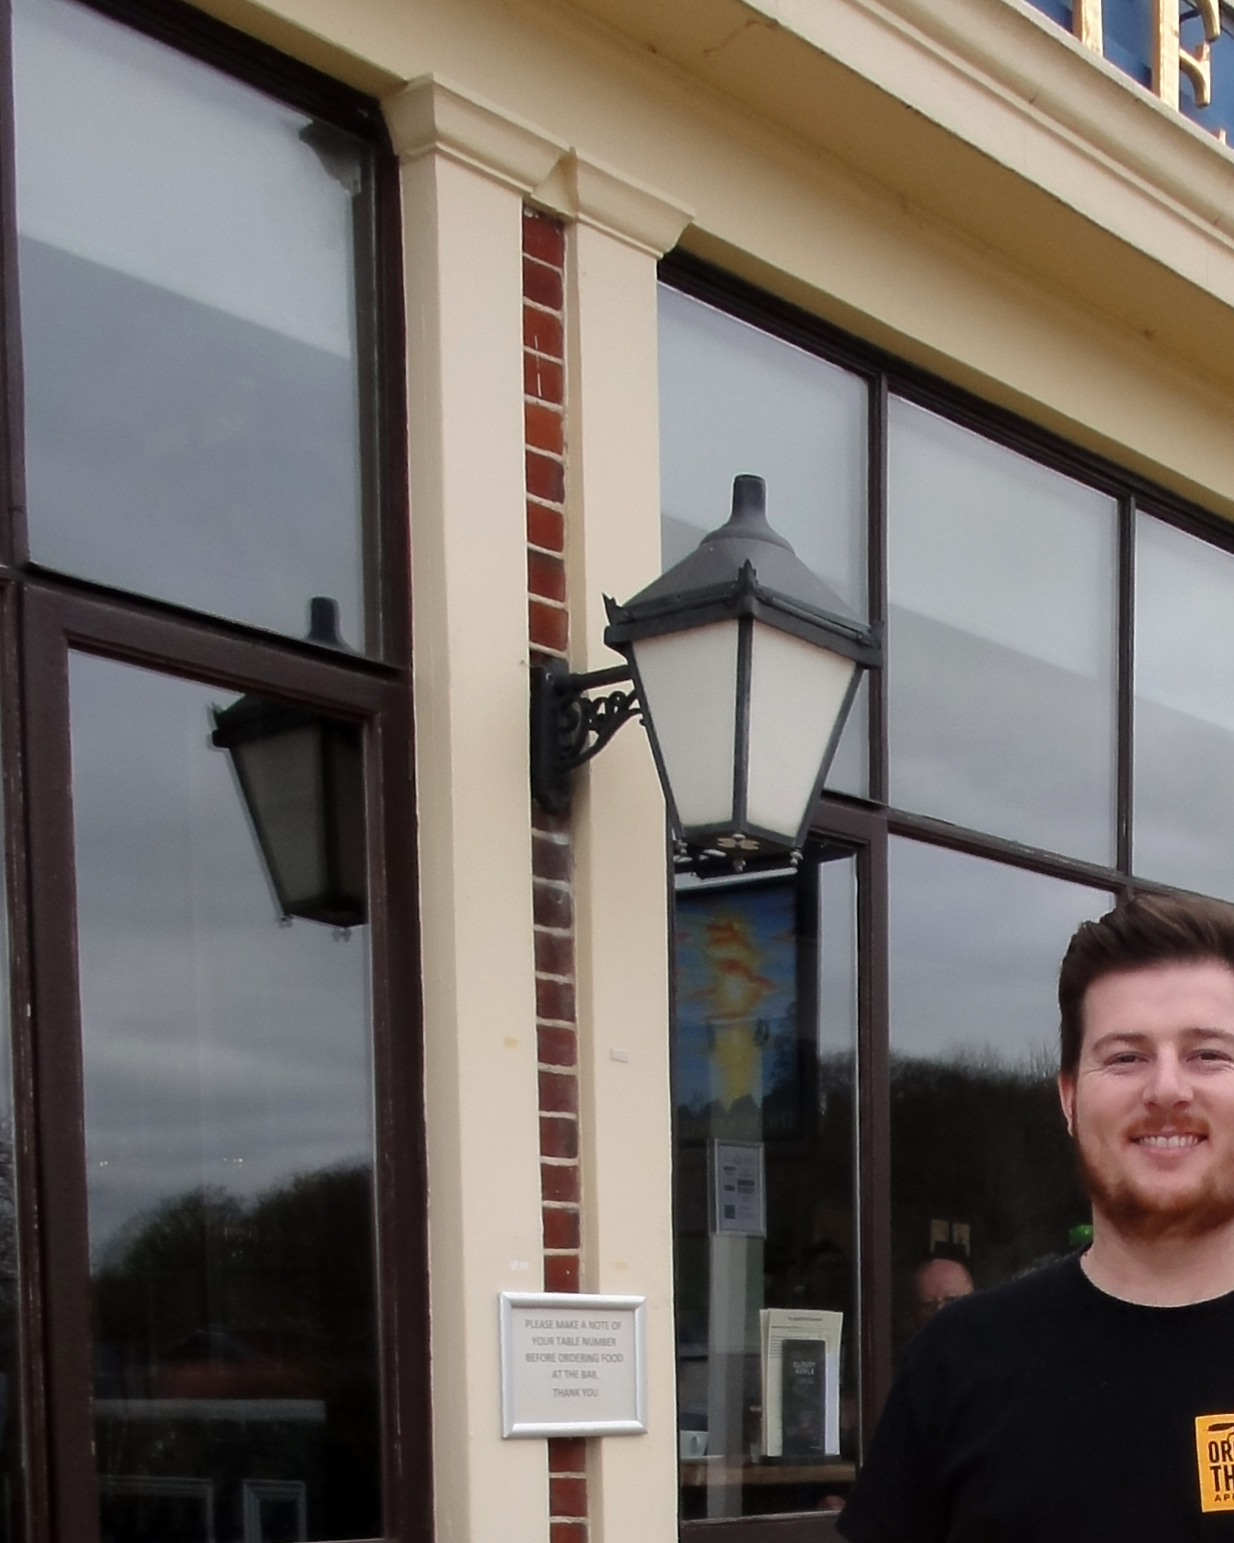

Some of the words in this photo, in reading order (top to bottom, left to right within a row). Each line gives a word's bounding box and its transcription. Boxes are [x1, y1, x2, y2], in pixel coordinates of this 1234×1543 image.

[525, 1319, 555, 1329] PLEASE
[556, 1320, 580, 1329] MAKE
[581, 1320, 587, 1329] A
[588, 1320, 610, 1331] NOTE
[611, 1321, 622, 1331] OF
[532, 1336, 555, 1347] YOUR
[556, 1336, 580, 1347] TABLE
[582, 1336, 617, 1348] NUMBER
[525, 1353, 557, 1363] BEFORE
[558, 1353, 600, 1363] ORDERING
[601, 1353, 624, 1363] FOOD
[552, 1369, 563, 1380] AT
[564, 1369, 580, 1380] THE
[553, 1387, 581, 1398] THANK
[582, 1387, 599, 1398] YOU
